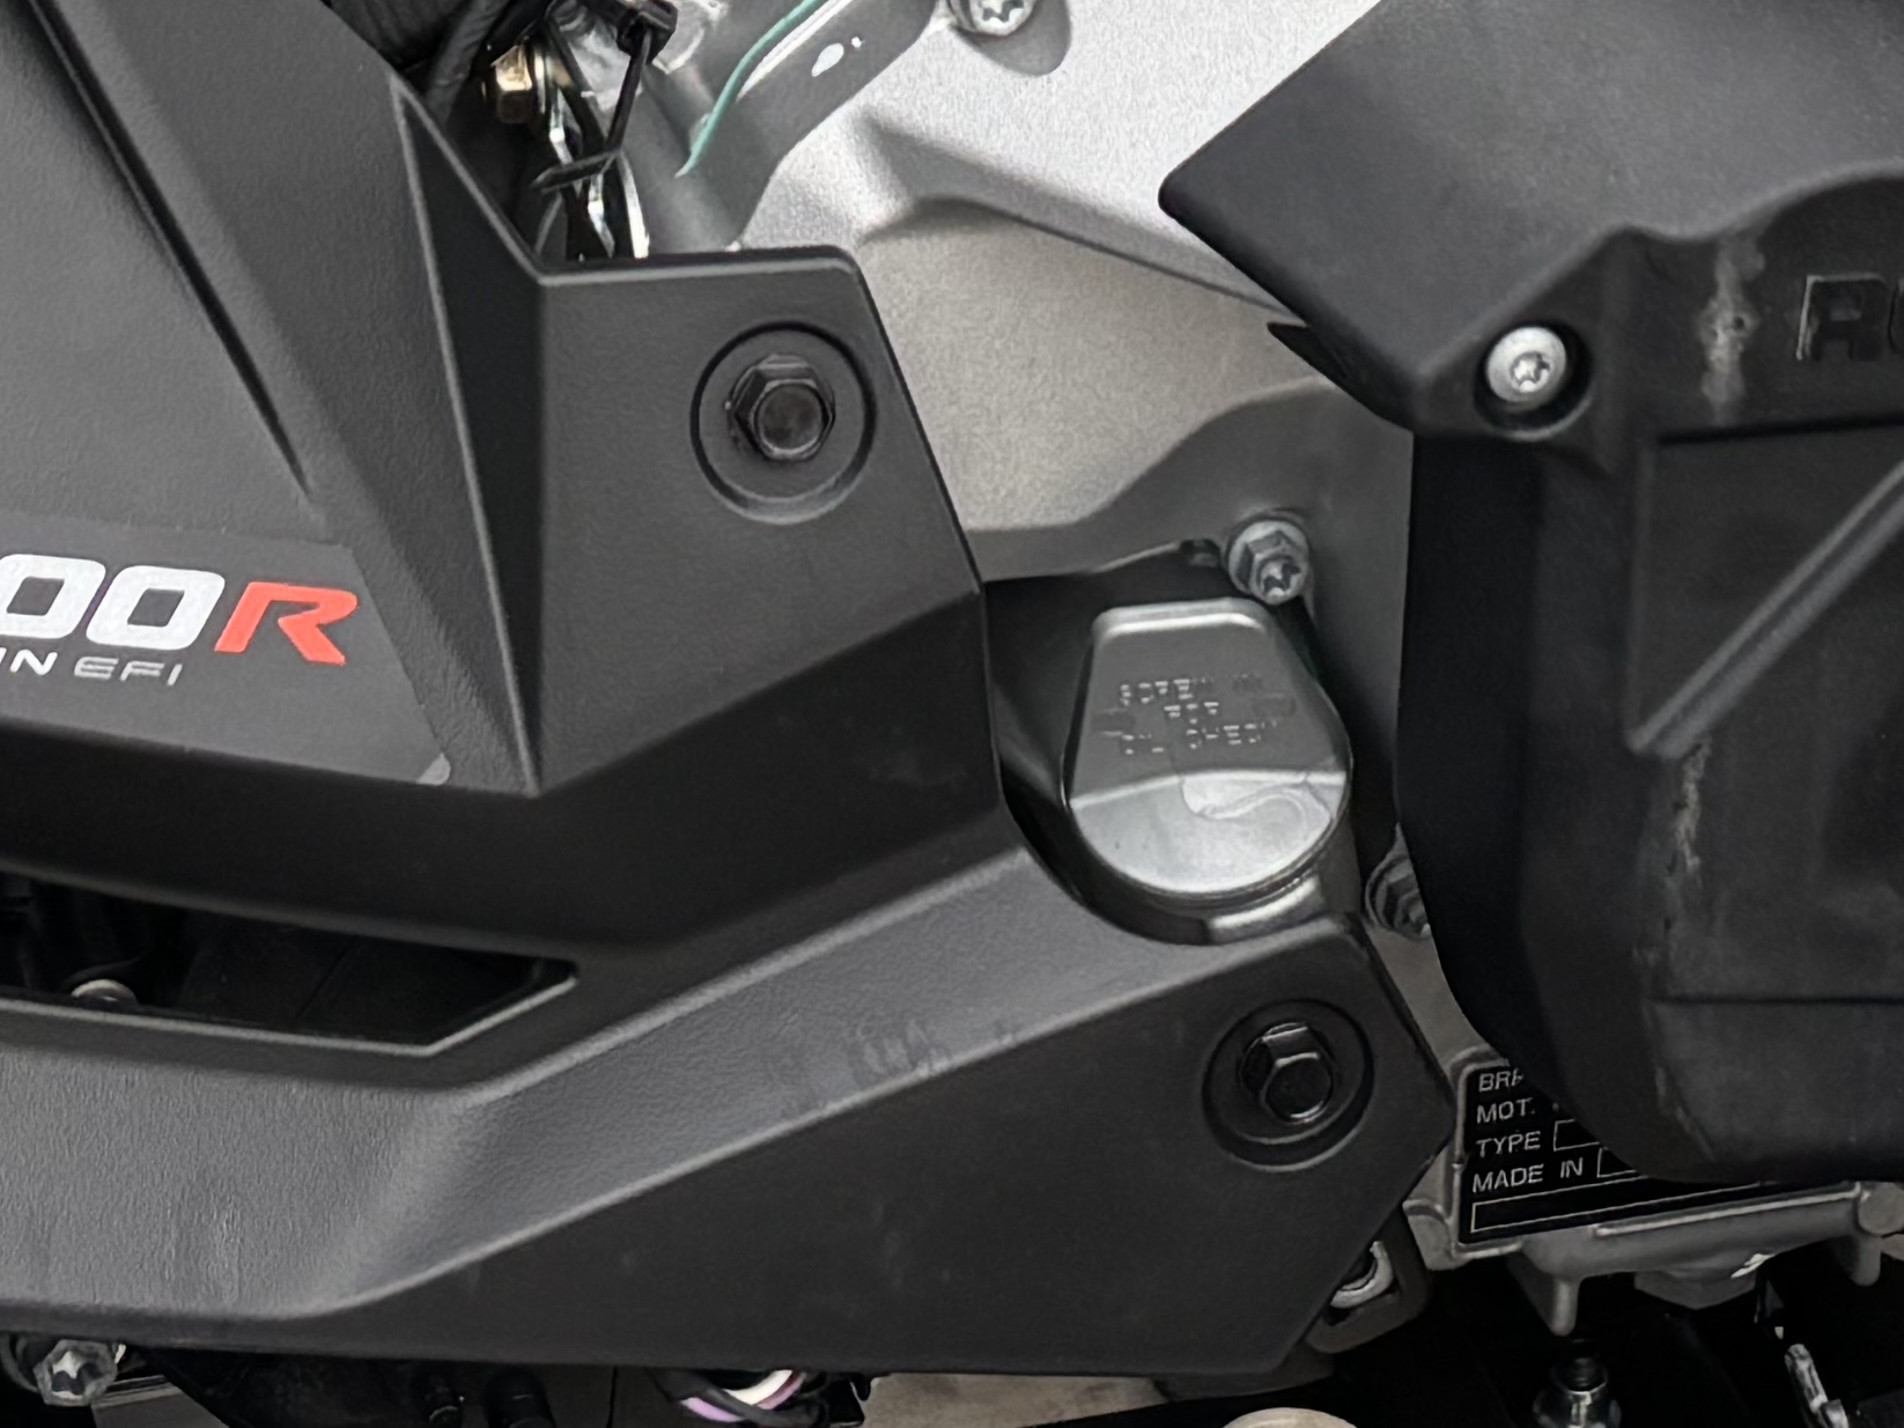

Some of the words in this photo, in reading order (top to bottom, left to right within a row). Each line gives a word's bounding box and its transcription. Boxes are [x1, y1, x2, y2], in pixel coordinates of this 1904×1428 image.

[73, 655, 184, 687] EFI
[1475, 1130, 1542, 1159] TYPE
[1471, 1163, 1545, 1194] MADE
[1559, 1156, 1585, 1180] IN
